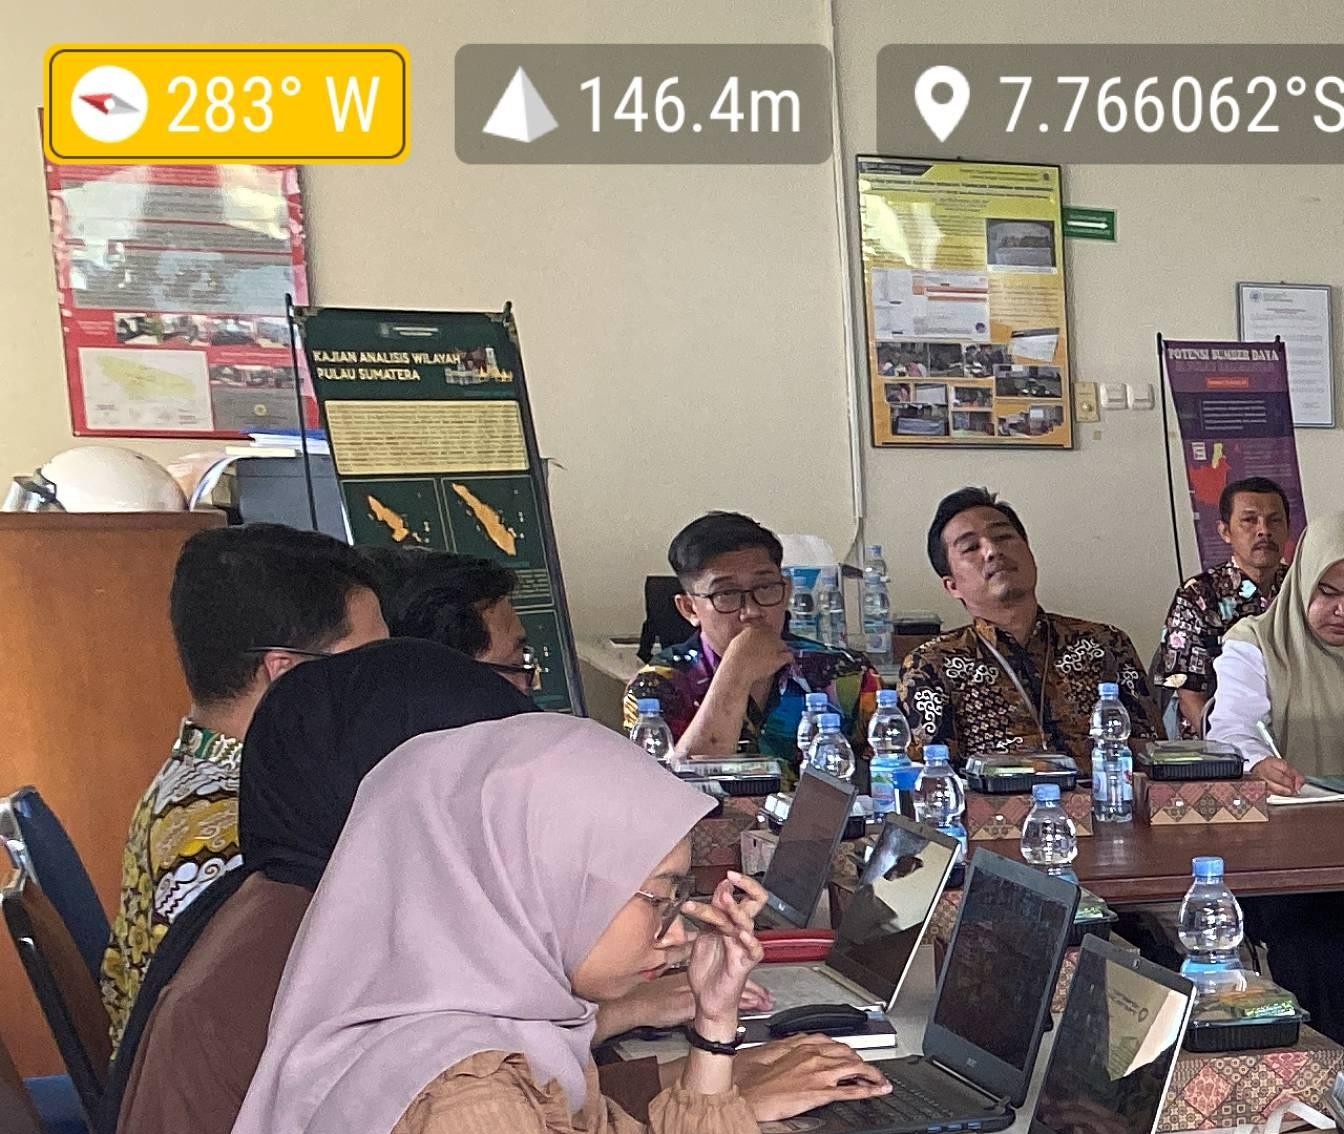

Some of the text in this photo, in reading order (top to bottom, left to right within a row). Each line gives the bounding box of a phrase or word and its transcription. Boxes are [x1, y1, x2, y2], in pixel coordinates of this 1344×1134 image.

[312, 350, 460, 365] KAJIAN ANALISIS WILAYAH
[316, 367, 421, 381] PULAU SUMATERA
